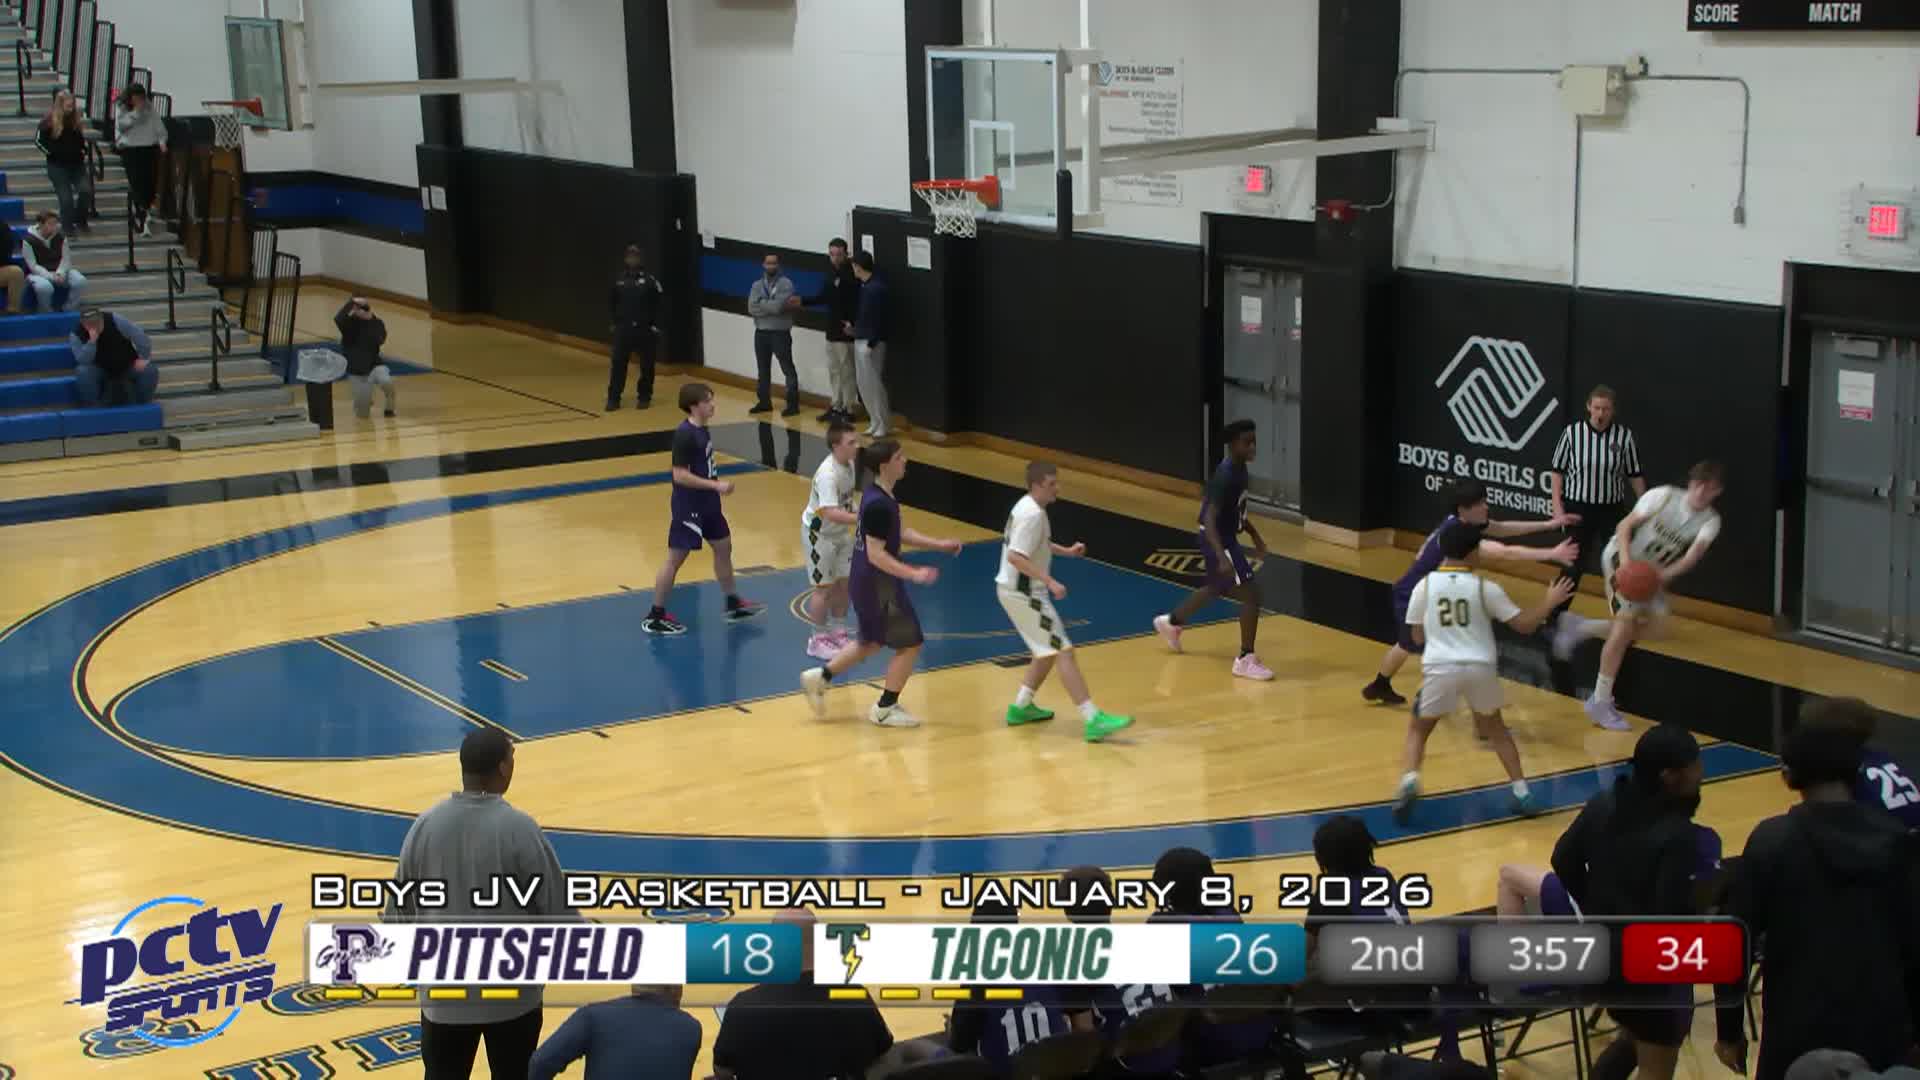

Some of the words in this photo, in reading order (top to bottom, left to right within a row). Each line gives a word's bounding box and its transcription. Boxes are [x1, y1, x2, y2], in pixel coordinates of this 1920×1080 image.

[1694, 3, 1739, 22] SCORE
[1808, 3, 1861, 22] MATCH
[1399, 443, 1449, 472] BOYS
[1453, 454, 1471, 477] &
[1474, 458, 1534, 489] GIRLS
[1425, 474, 1443, 493] OF
[1486, 486, 1553, 516] ERKSHIRE
[1438, 597, 1471, 628] 20
[1866, 763, 1920, 811] 25
[1001, 1001, 1052, 1055] 10
